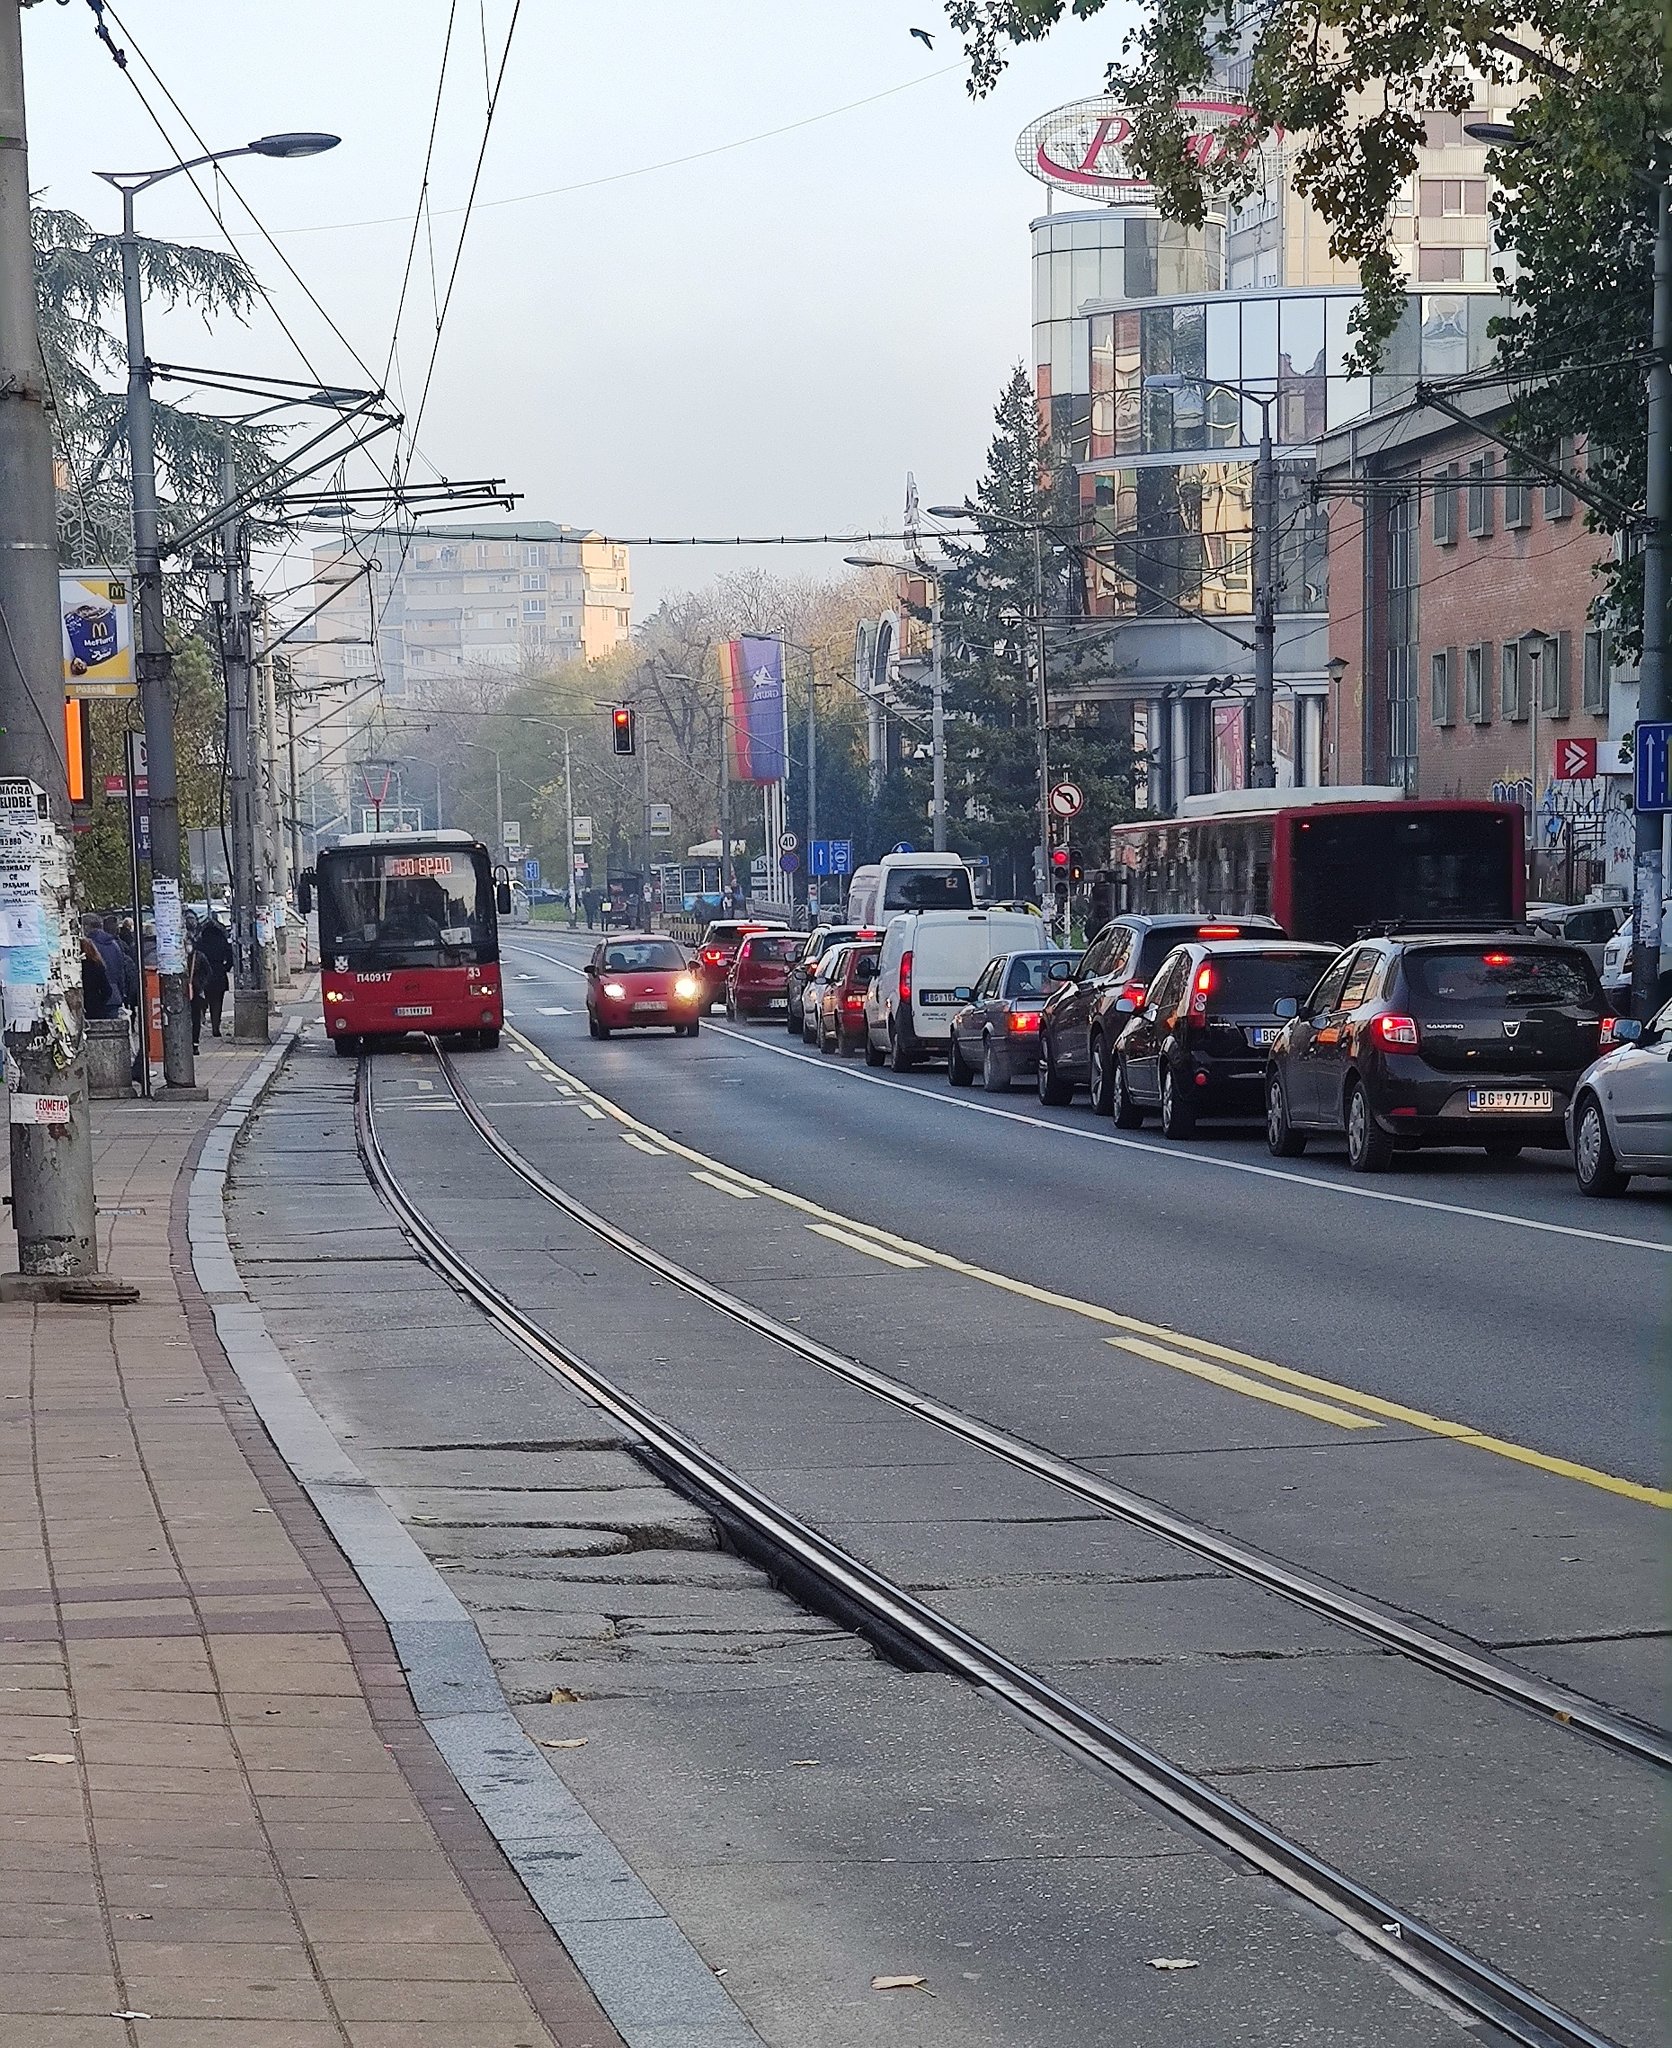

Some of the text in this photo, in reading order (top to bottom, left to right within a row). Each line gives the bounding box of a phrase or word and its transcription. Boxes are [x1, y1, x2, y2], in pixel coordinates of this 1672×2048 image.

[84, 634, 115, 647] McFlurry
[782, 836, 795, 848] 40
[418, 856, 452, 875] БРДО
[356, 972, 392, 983] П40917
[468, 967, 481, 978] 33
[1263, 1029, 1275, 1042] BG
[1479, 1092, 1495, 1106] BG
